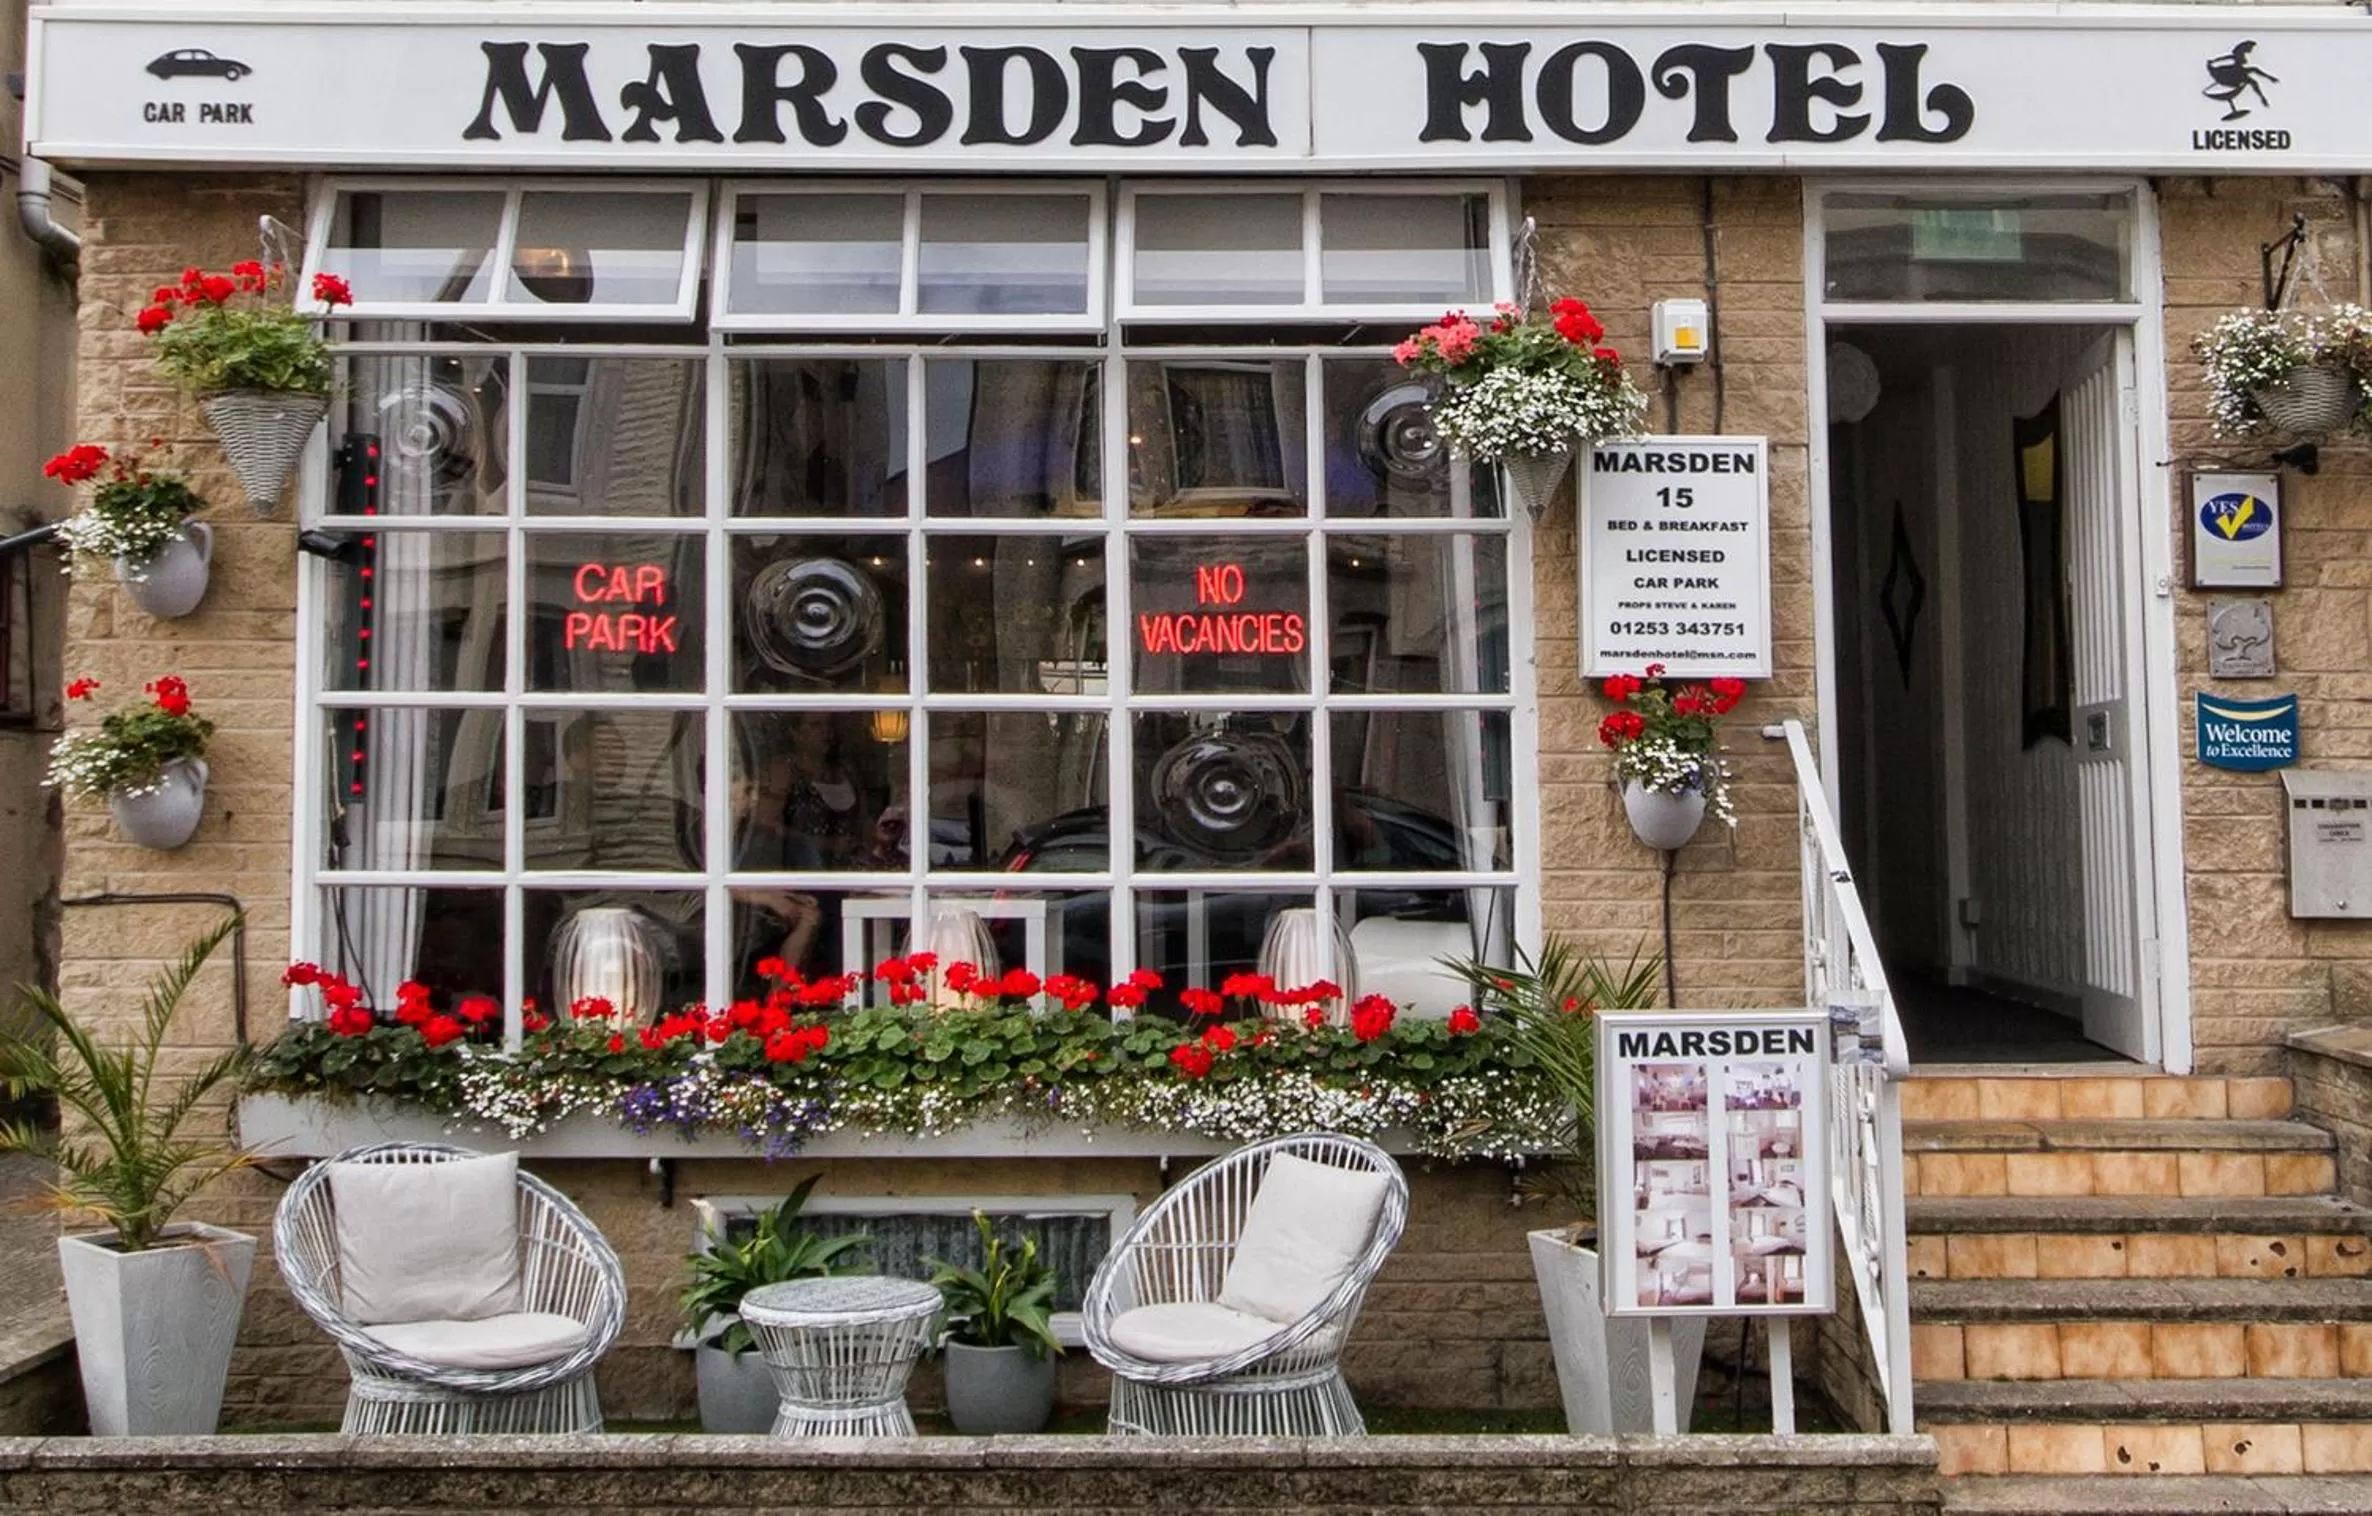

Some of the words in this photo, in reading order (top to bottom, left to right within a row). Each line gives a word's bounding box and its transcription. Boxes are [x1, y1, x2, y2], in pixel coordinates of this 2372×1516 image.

[462, 41, 1278, 148] MARSDEN
[1416, 41, 1975, 146] HOTEL
[144, 102, 184, 123] CAR
[200, 103, 253, 124] PARK
[2193, 129, 2291, 150] LICENSED
[1594, 452, 1755, 473] MARSDEN
[1656, 486, 1694, 508] 15
[2209, 500, 2238, 513] YES
[1607, 520, 1638, 531] BED
[1643, 520, 1653, 531] &
[1659, 520, 1749, 532] BREAKFAST
[1626, 549, 1726, 564] LICENSED
[574, 562, 667, 605] CAR
[1195, 562, 1247, 606] NO
[1633, 577, 1668, 589] CAR
[1673, 577, 1719, 589] PARK
[1618, 601, 1652, 609] PROPS
[562, 611, 678, 655] PARK
[1138, 611, 1306, 655] VACANCIES
[1610, 621, 1670, 635] 01253
[1676, 621, 1745, 636] 343751
[1599, 649, 1757, 660] marsdenhotel@msn.com
[2205, 723, 2292, 744] Welcome
[2206, 745, 2220, 757] to
[2221, 743, 2293, 758] Excellence
[1619, 1028, 1815, 1058] MARSDEN
